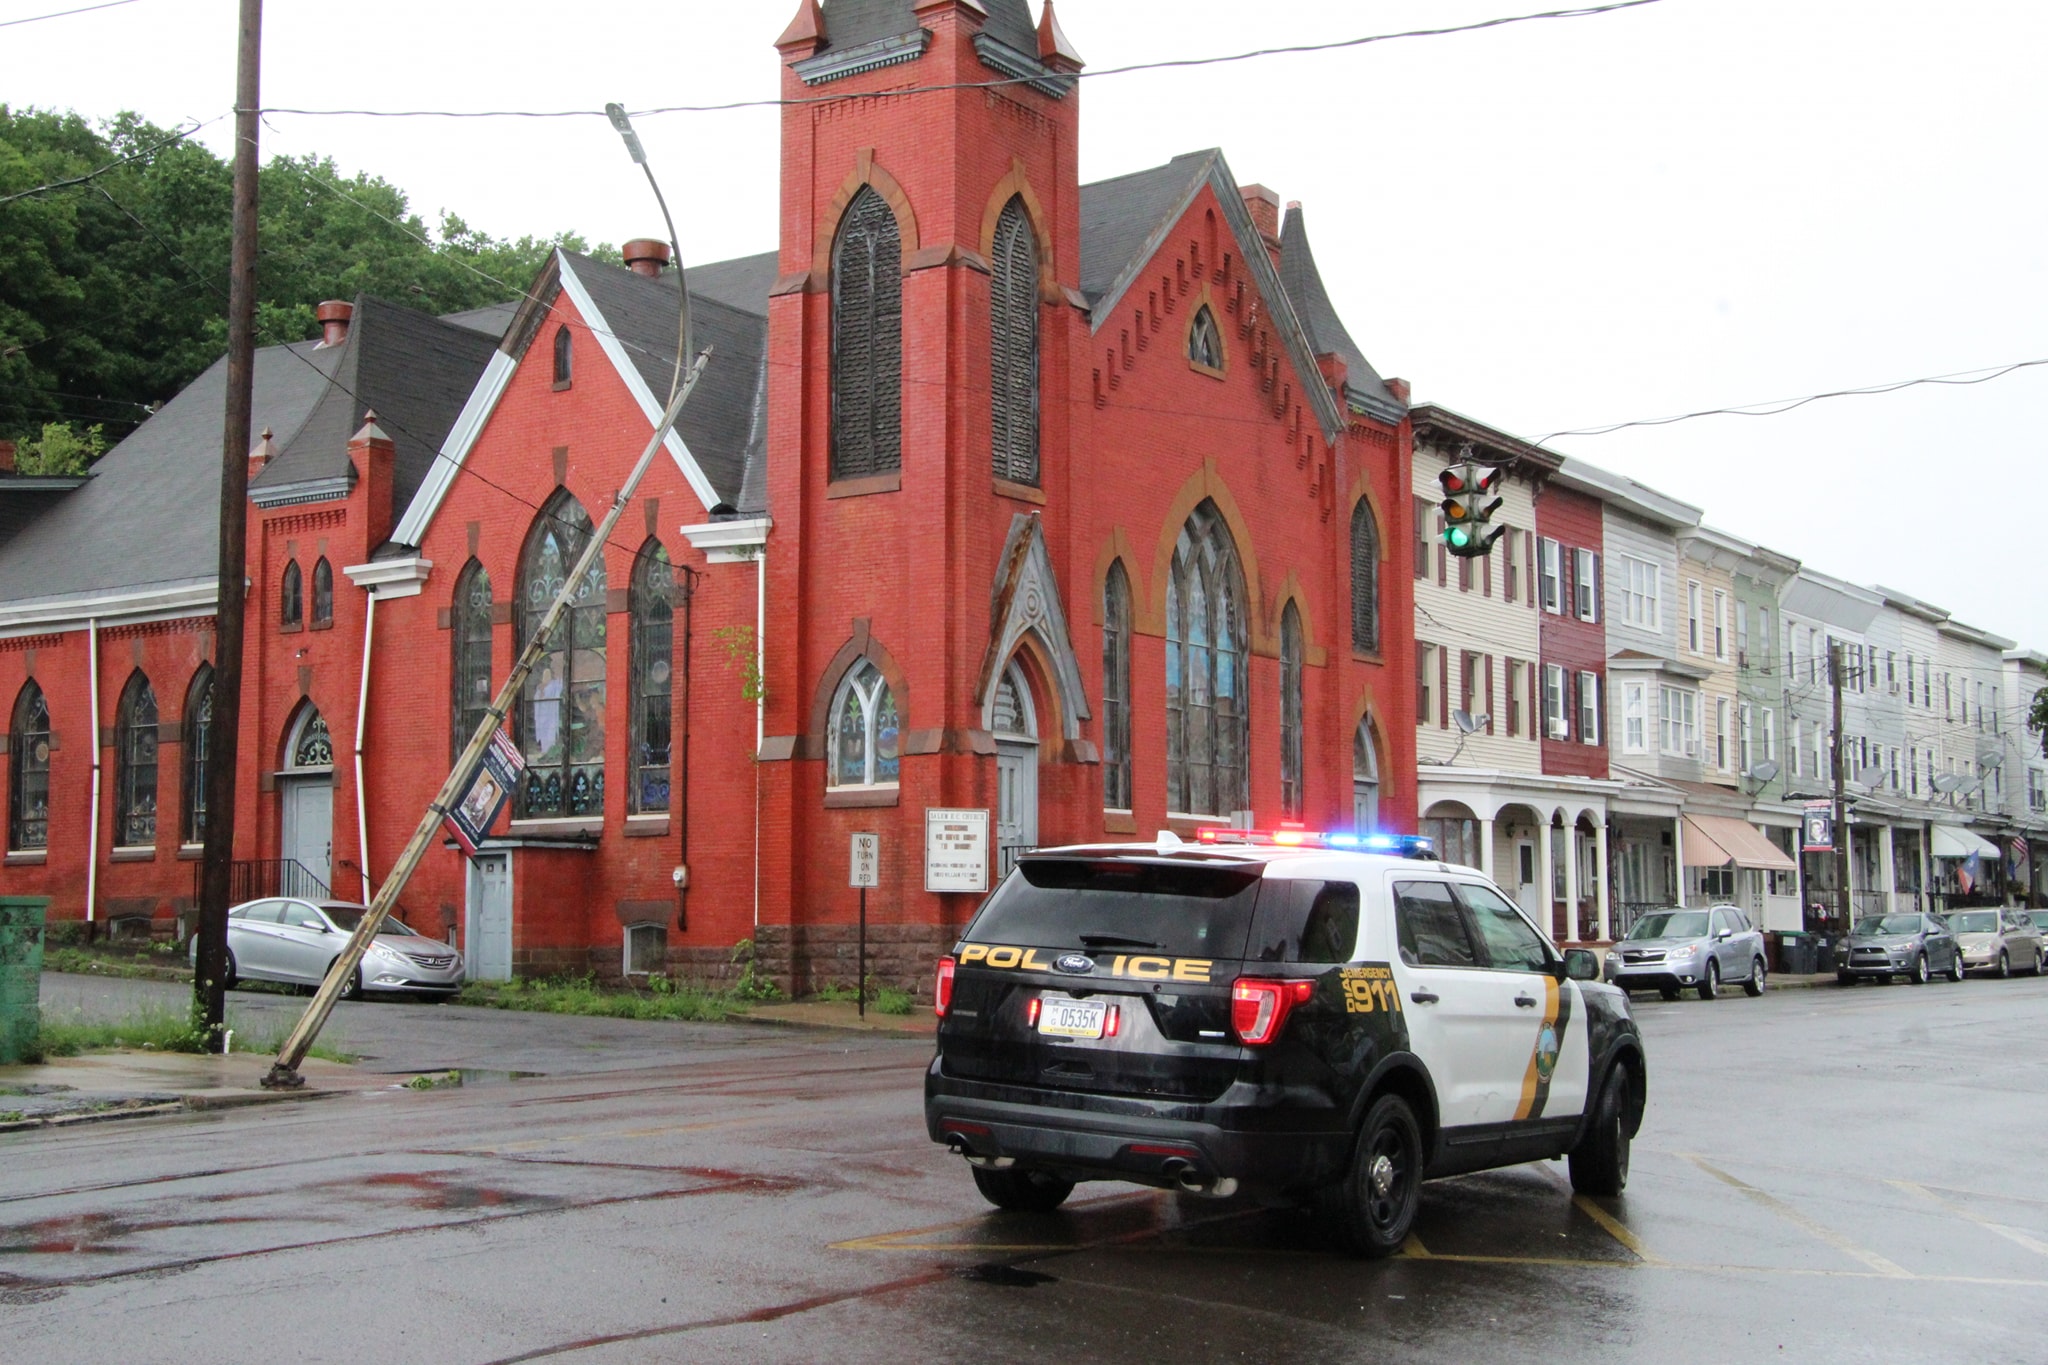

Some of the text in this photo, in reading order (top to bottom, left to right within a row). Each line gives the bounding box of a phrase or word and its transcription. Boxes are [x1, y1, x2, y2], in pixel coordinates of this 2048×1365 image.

[858, 837, 872, 848] NO
[857, 851, 873, 860] TURN
[860, 862, 870, 871] ON
[858, 873, 871, 882] RED
[1346, 967, 1391, 979] EMERGENCY
[1339, 968, 1356, 1013] DIAL
[1351, 979, 1401, 1013] 911
[1060, 1008, 1098, 1029] 0535K
